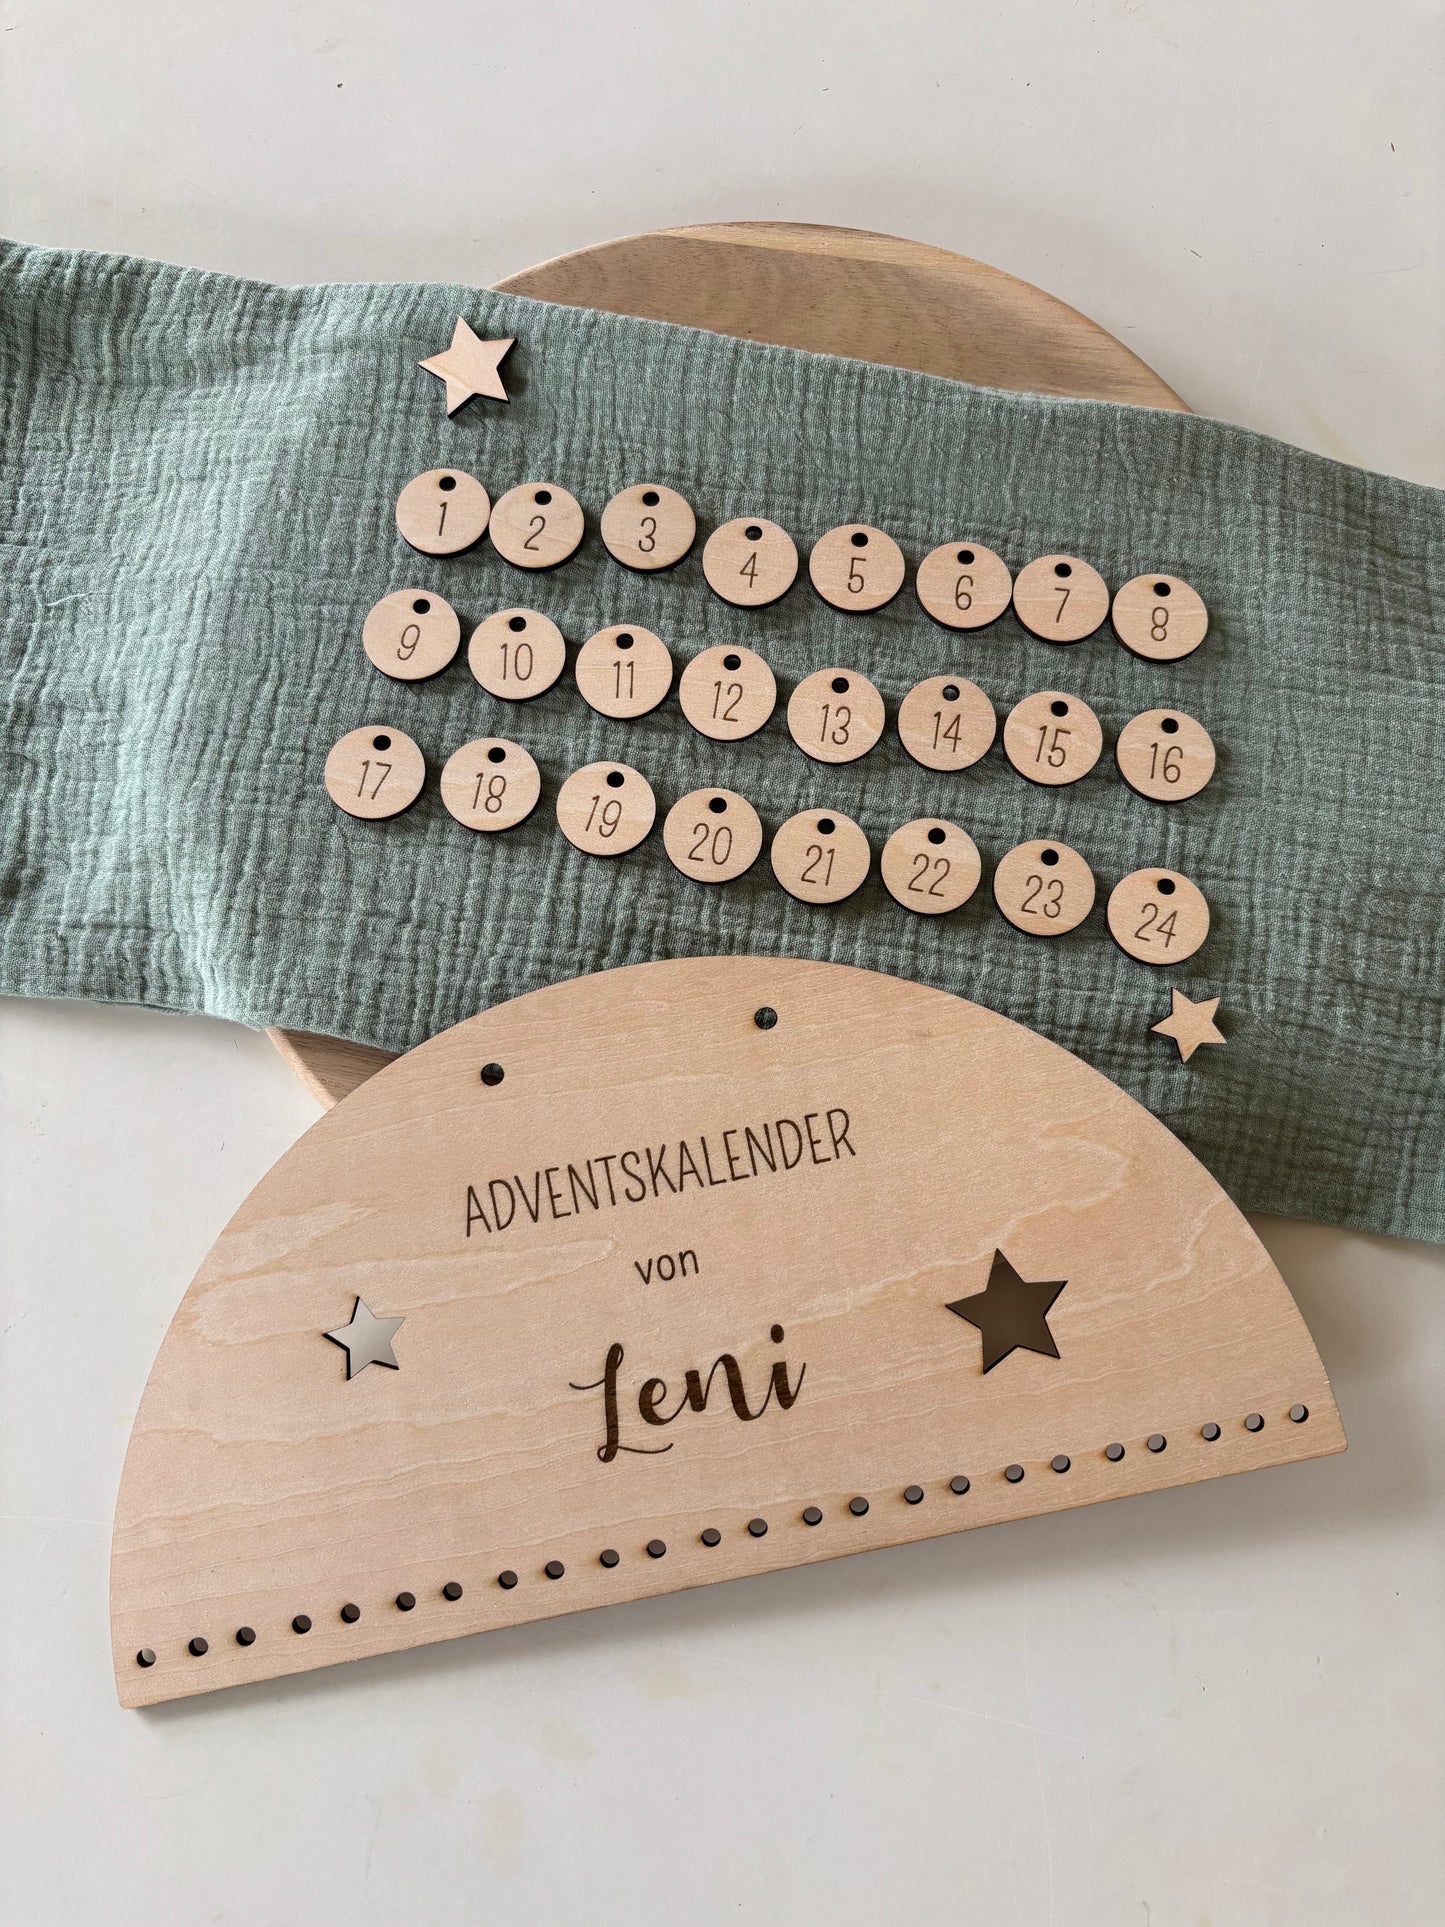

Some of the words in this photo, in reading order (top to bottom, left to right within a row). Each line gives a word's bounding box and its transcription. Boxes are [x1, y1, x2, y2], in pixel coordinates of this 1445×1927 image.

[438, 502, 447, 536] 1
[524, 516, 546, 551] 2
[639, 517, 656, 552] 3
[739, 552, 758, 588] 4
[847, 558, 867, 594] 5
[955, 575, 973, 610] 6
[1054, 588, 1070, 623] 7
[397, 624, 420, 660] 9
[1151, 607, 1169, 641] 8
[500, 643, 533, 680] 10
[613, 661, 634, 698] 11
[712, 681, 744, 722] 12
[820, 704, 851, 745] 13
[933, 711, 962, 753] 14
[1035, 725, 1071, 767] 15
[1150, 742, 1183, 783] 16
[357, 760, 391, 800] 17
[472, 772, 506, 813] 18
[585, 795, 622, 838] 19
[688, 823, 732, 865] 20
[801, 844, 836, 886] 21
[908, 853, 950, 897] 22
[1021, 875, 1064, 918] 23
[1134, 903, 1178, 948] 24
[466, 1108, 856, 1237] ADVENTSKALENDER
[634, 1250, 699, 1284] von
[569, 1324, 806, 1463] Leni
